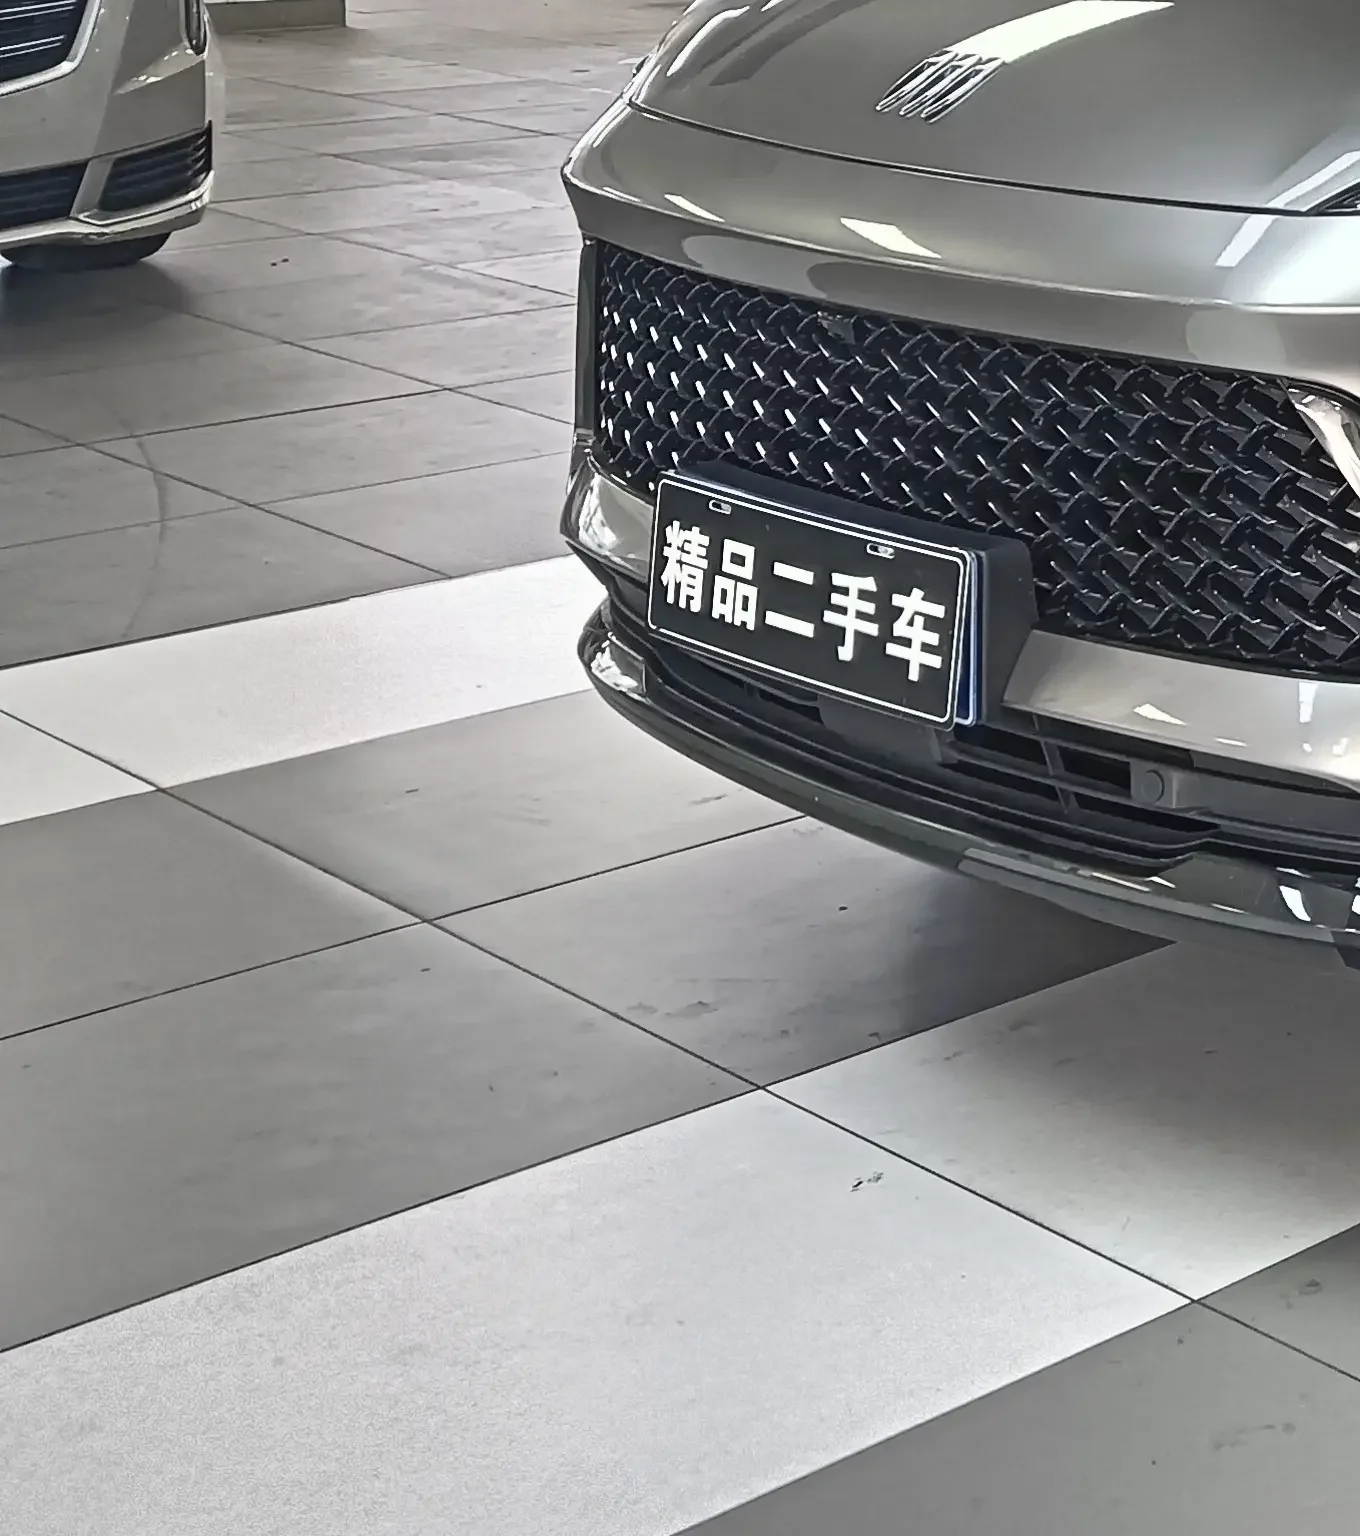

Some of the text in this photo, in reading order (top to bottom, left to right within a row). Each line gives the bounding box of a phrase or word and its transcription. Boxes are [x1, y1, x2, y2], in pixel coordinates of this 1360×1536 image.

[661, 520, 947, 682] 精品二手车
